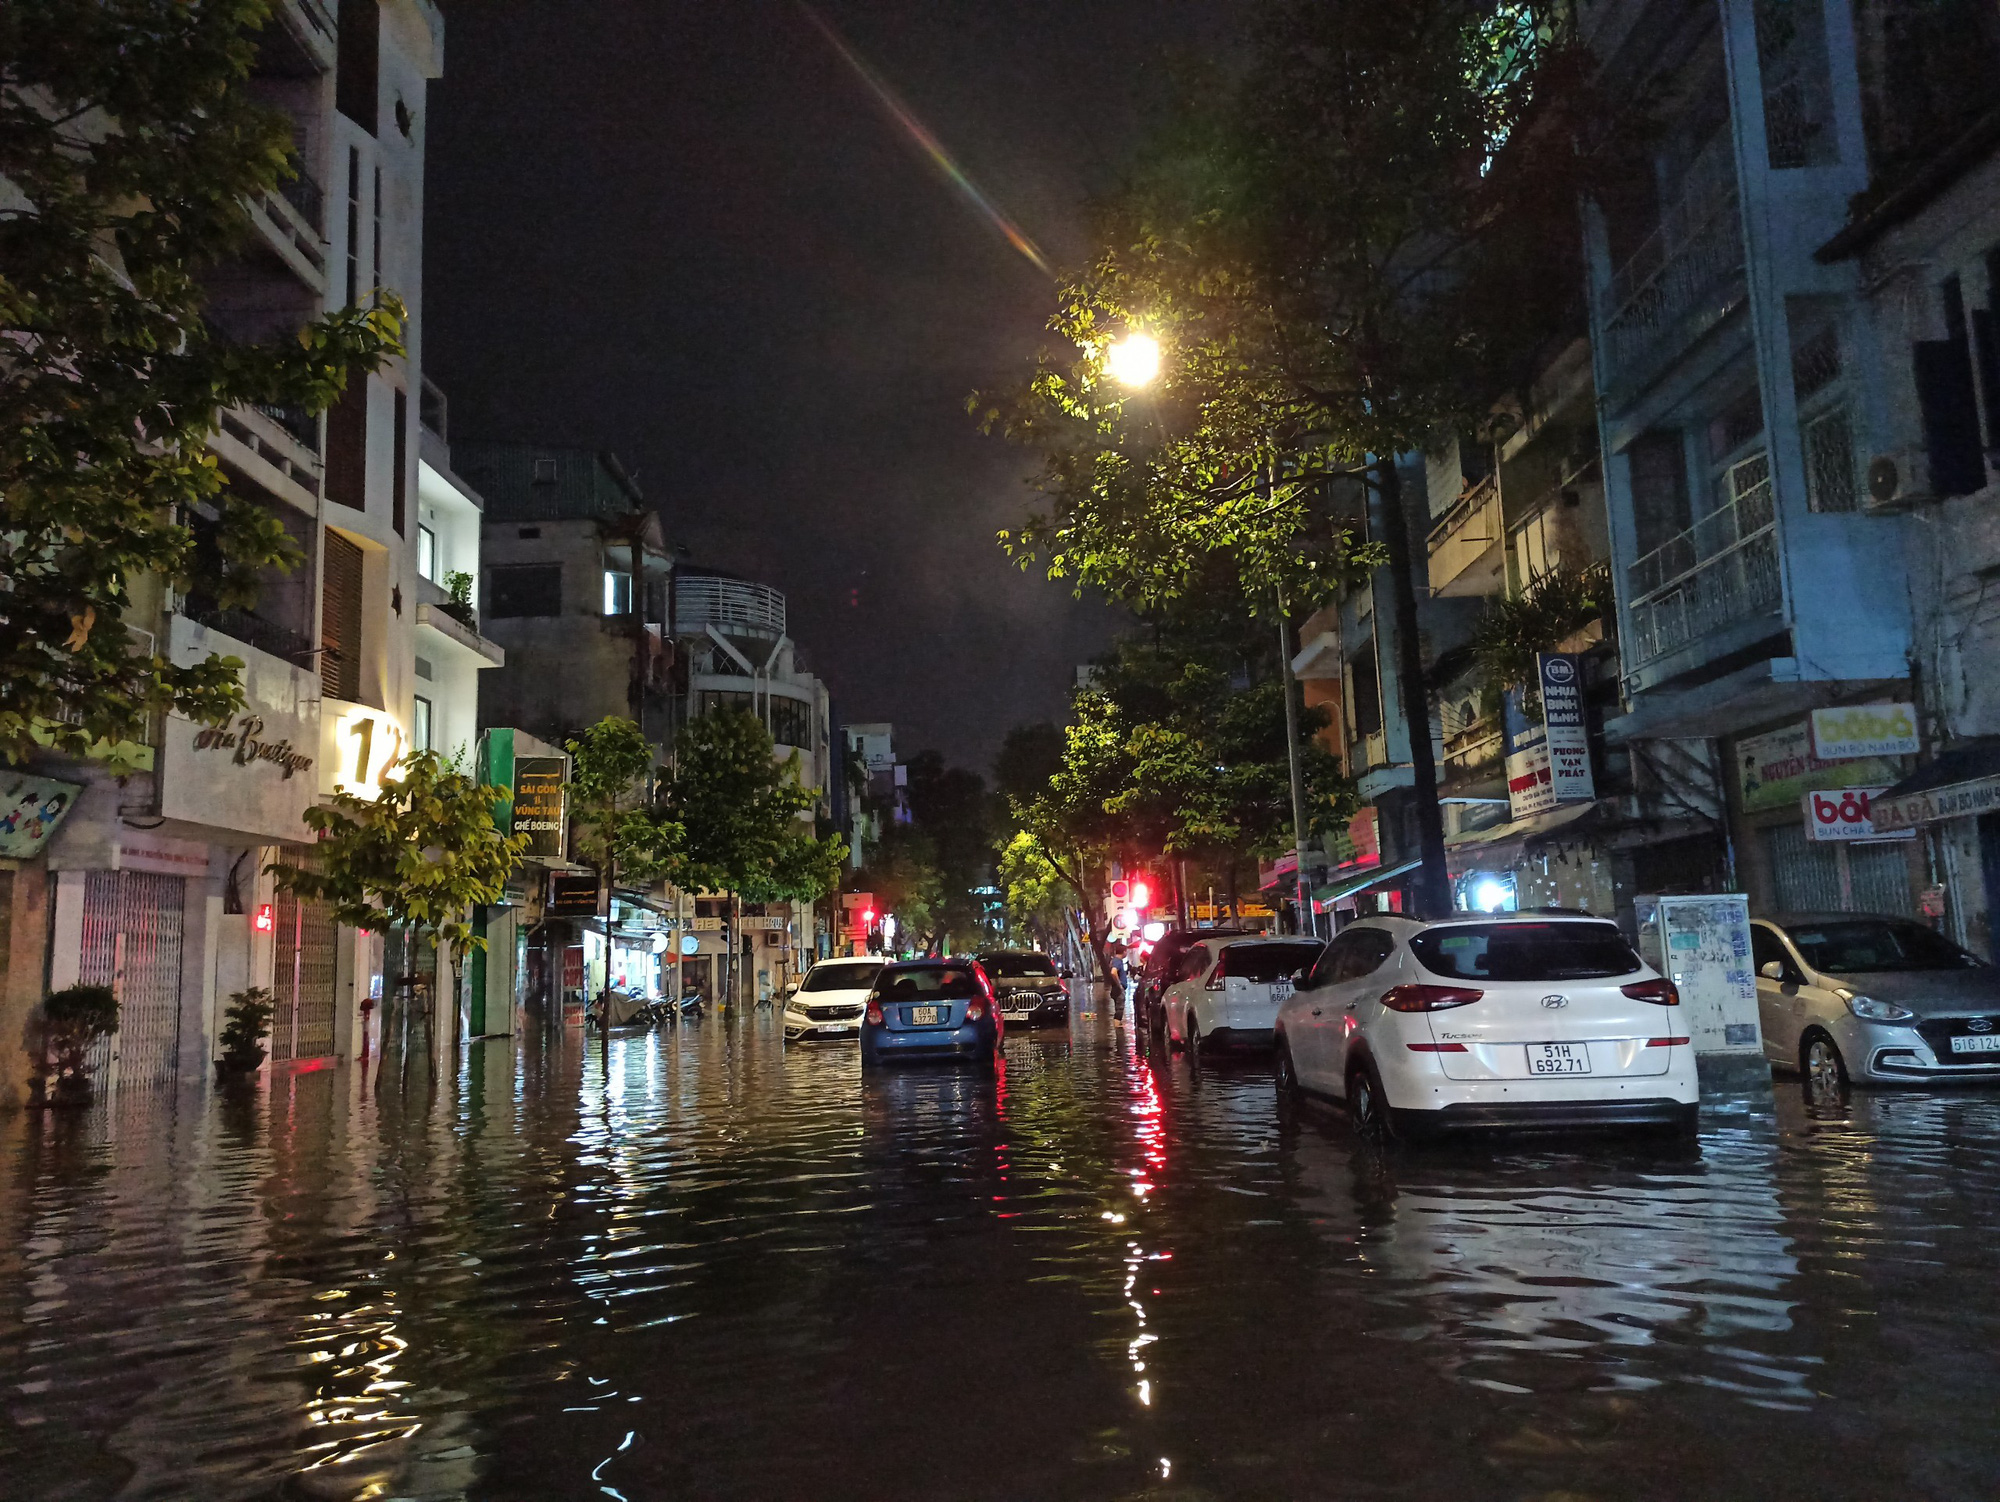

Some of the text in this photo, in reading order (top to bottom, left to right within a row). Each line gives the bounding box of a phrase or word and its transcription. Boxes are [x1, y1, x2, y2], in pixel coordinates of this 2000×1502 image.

[1552, 747, 1586, 756] PHONG
[1558, 767, 1586, 778] PHÁT
[514, 818, 559, 831] GHẾ BOEING
[918, 1007, 932, 1016] 60A
[1544, 1045, 1571, 1058] 51H
[1536, 1058, 1583, 1072] 692.71
